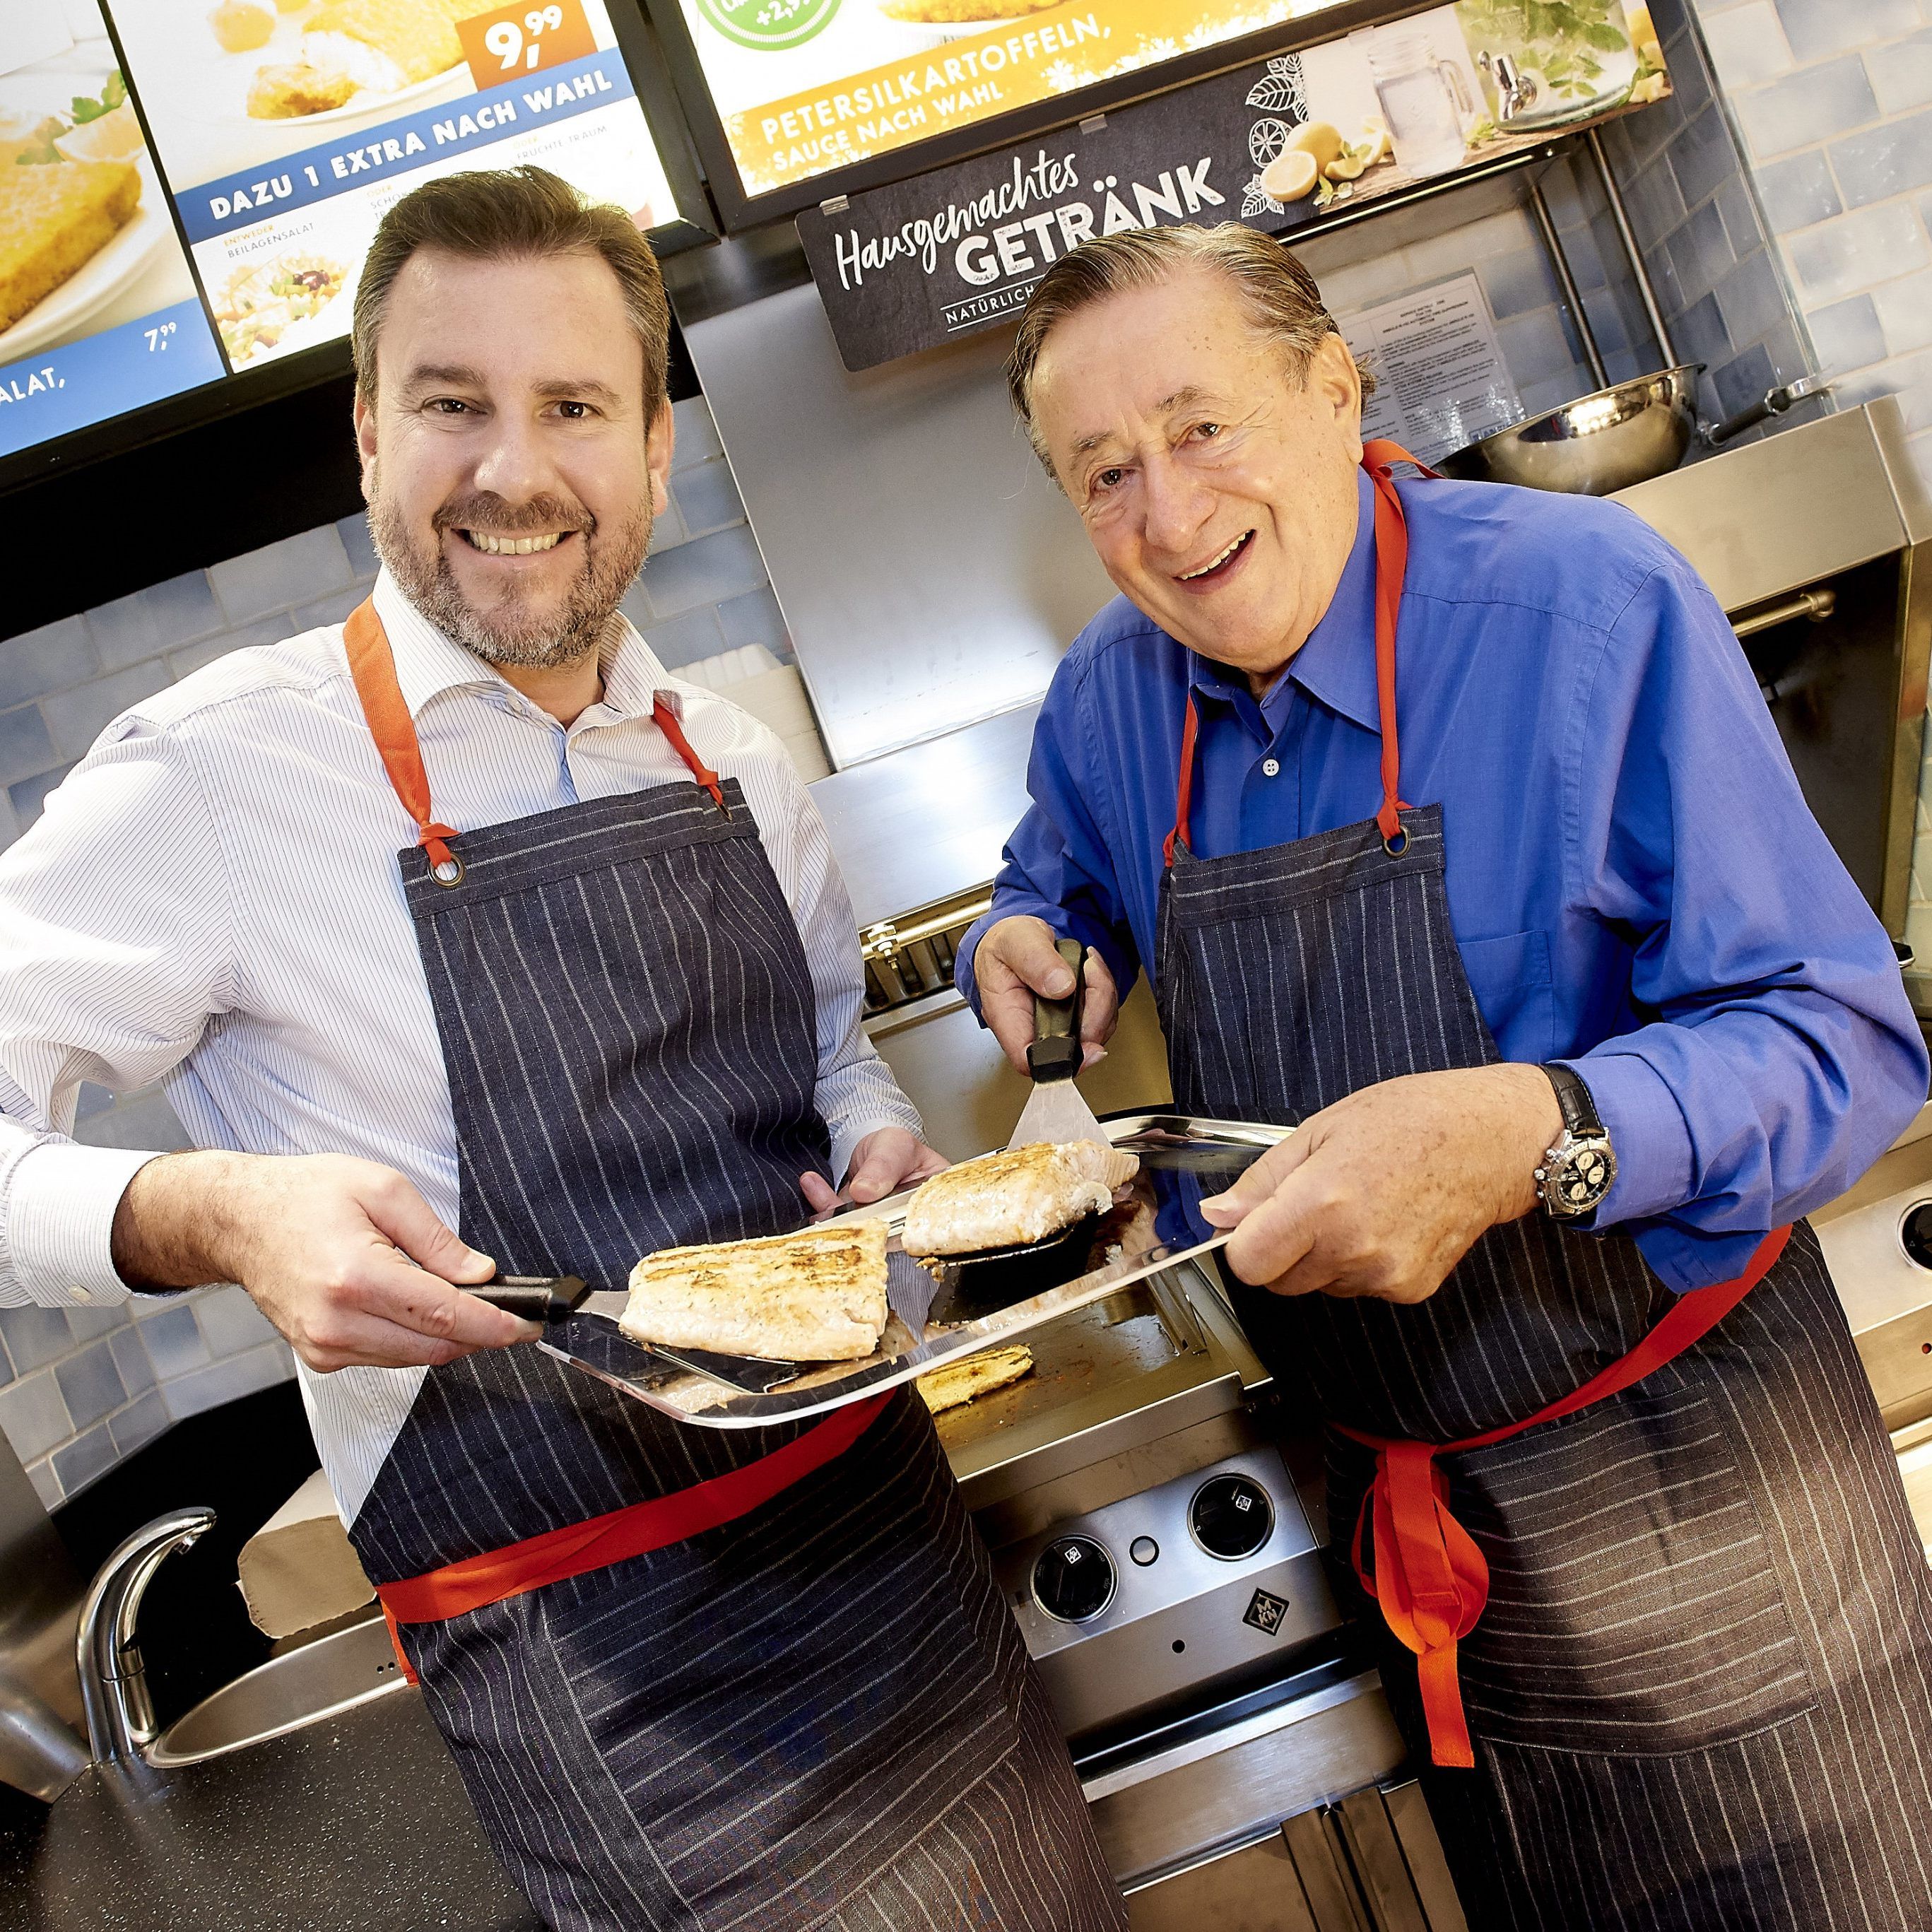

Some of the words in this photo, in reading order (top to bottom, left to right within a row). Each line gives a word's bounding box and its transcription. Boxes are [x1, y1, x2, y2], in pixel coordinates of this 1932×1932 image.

[760, 13, 1112, 145] PETERSILKARTOFFELN,
[856, 104, 927, 143] NACH
[931, 81, 1004, 117] WAHL
[208, 174, 293, 220] DAZU
[303, 165, 320, 187] 1
[329, 131, 427, 179] EXTRA
[432, 100, 517, 146] NACH
[522, 69, 613, 113] WAHL
[223, 224, 274, 247] ENTWEDER
[227, 222, 314, 258] BEILAGENSALAT
[835, 149, 1079, 290] Hausgemachtes
[954, 156, 1227, 286] GETRÄNK
[945, 284, 1035, 325] NATÜRLICH
